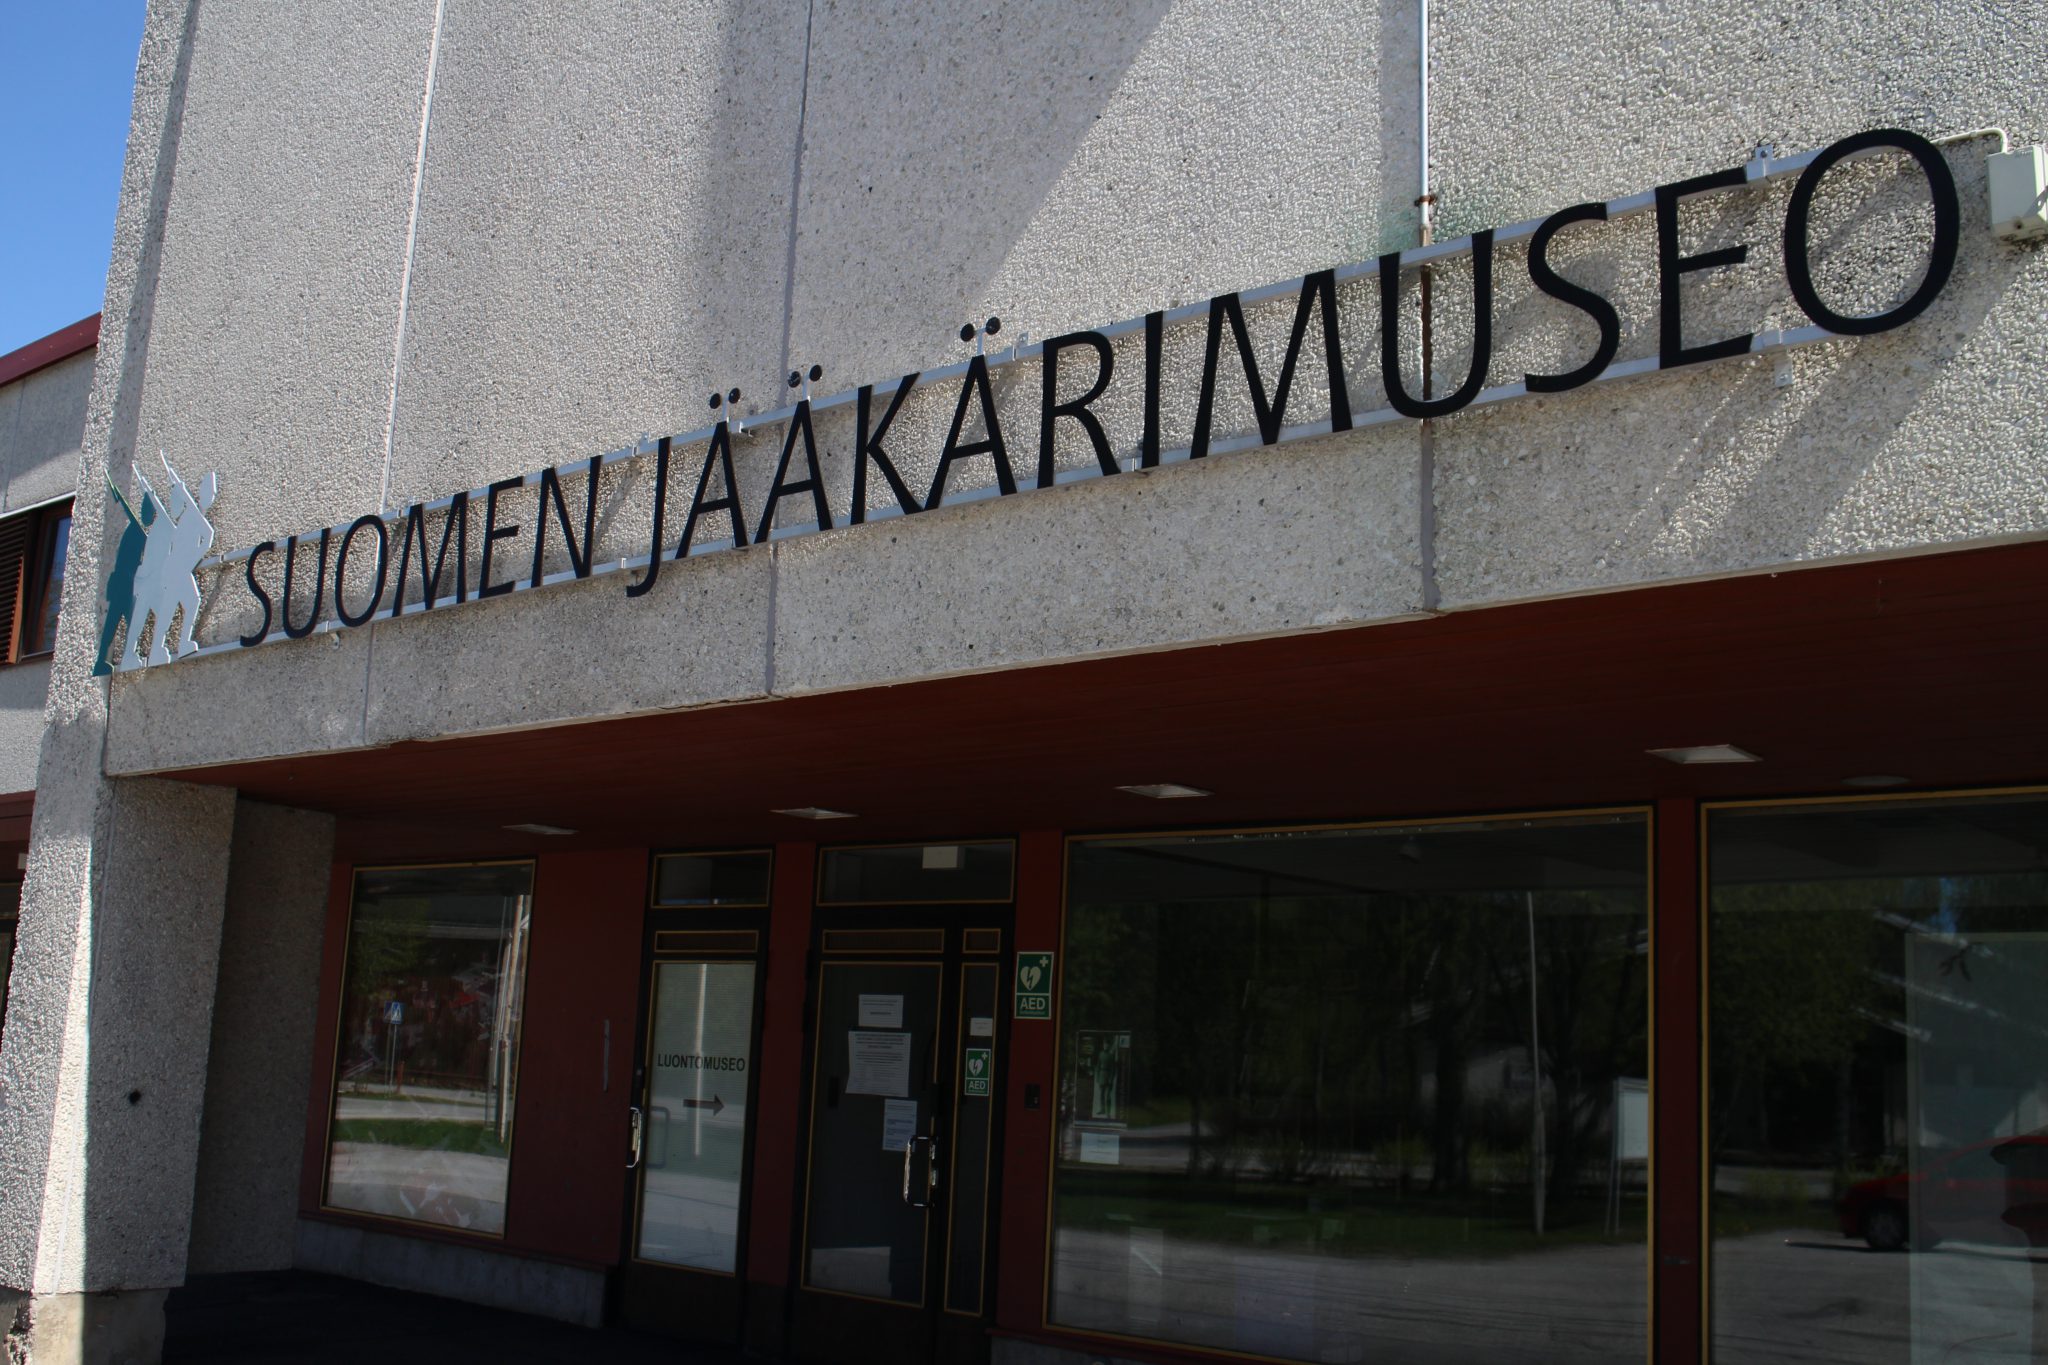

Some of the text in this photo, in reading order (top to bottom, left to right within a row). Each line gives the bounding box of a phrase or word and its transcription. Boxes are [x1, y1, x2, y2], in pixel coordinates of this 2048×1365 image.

[240, 128, 1960, 648] SUOMEN JÄÄKÄRIMUSEO
[1020, 997, 1046, 1010] AED
[657, 1053, 746, 1072] LUONTOMUSEO
[968, 1080, 986, 1090] AED
